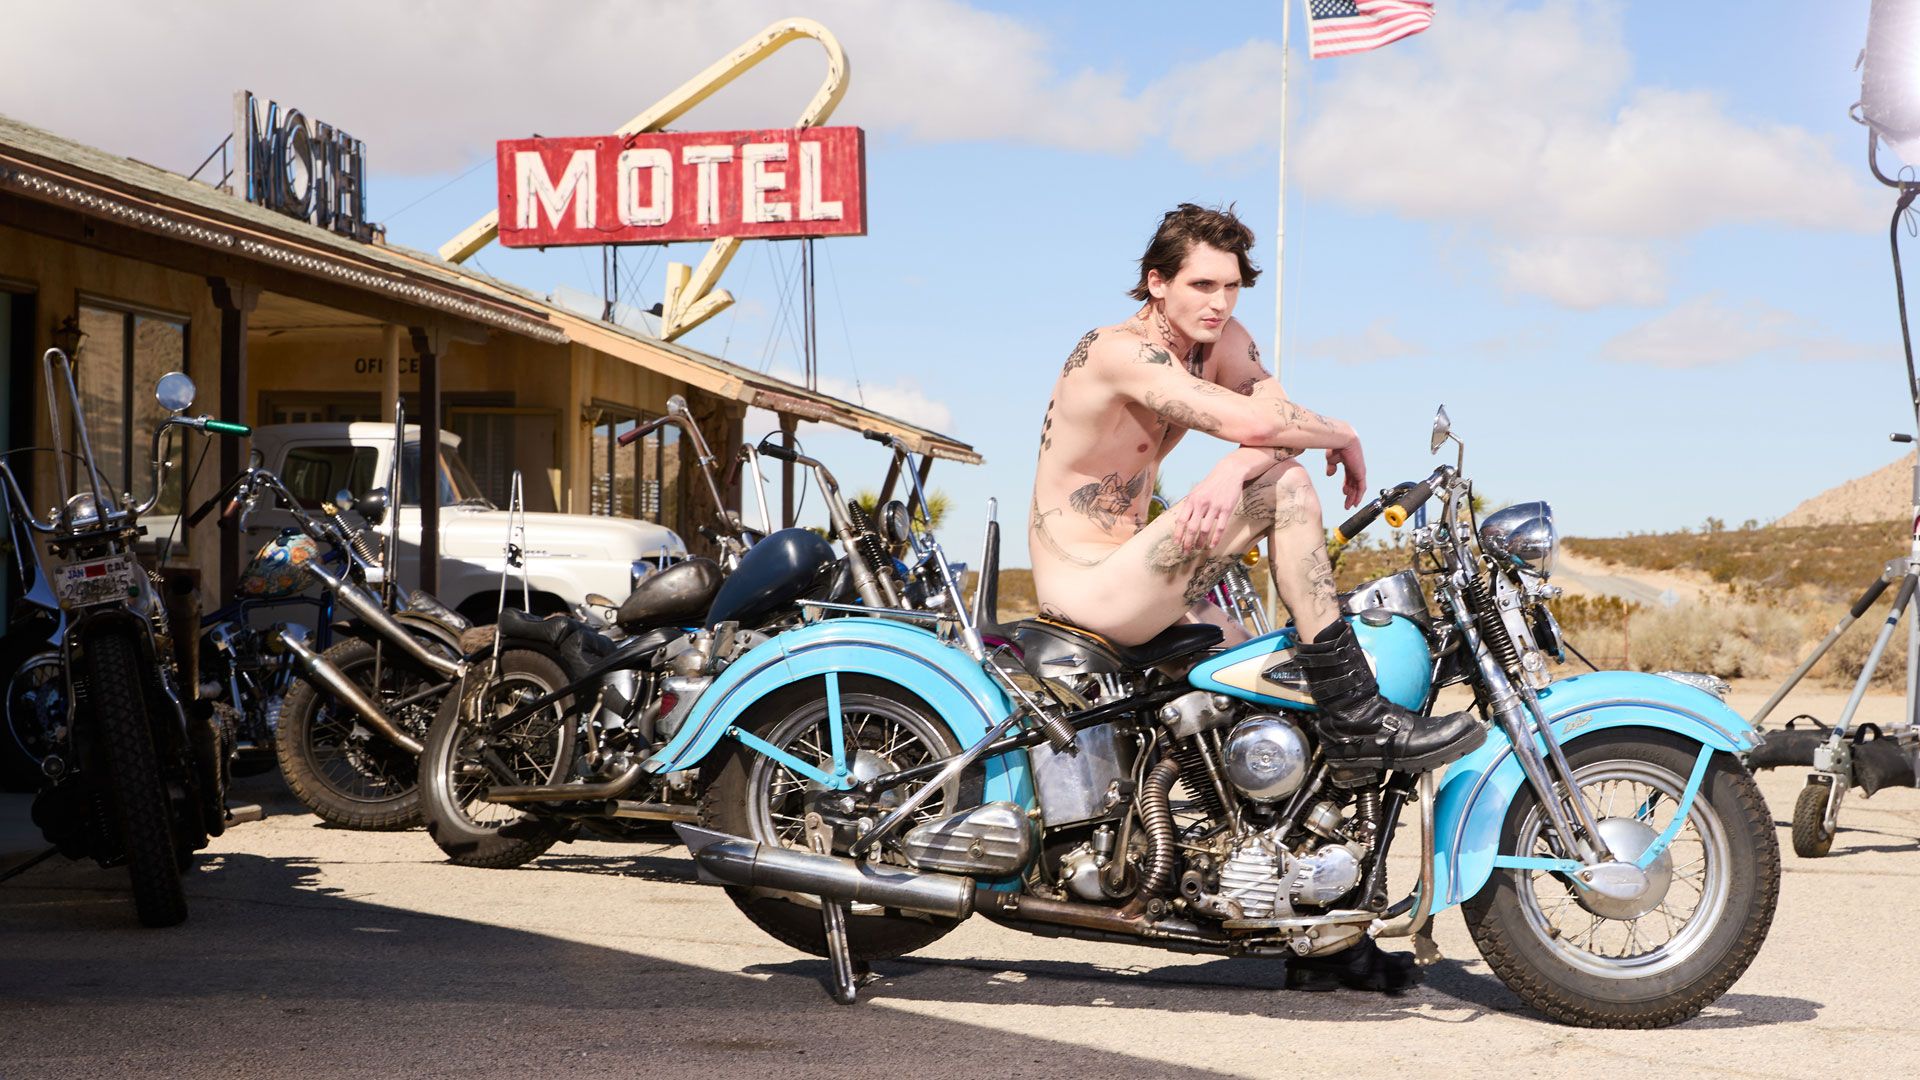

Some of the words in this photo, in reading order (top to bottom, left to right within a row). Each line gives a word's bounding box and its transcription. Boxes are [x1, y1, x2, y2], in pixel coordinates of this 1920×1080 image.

[514, 141, 844, 230] MOTEL
[355, 358, 420, 374] OFCE
[67, 567, 84, 579] JAN
[107, 561, 129, 573] CAL
